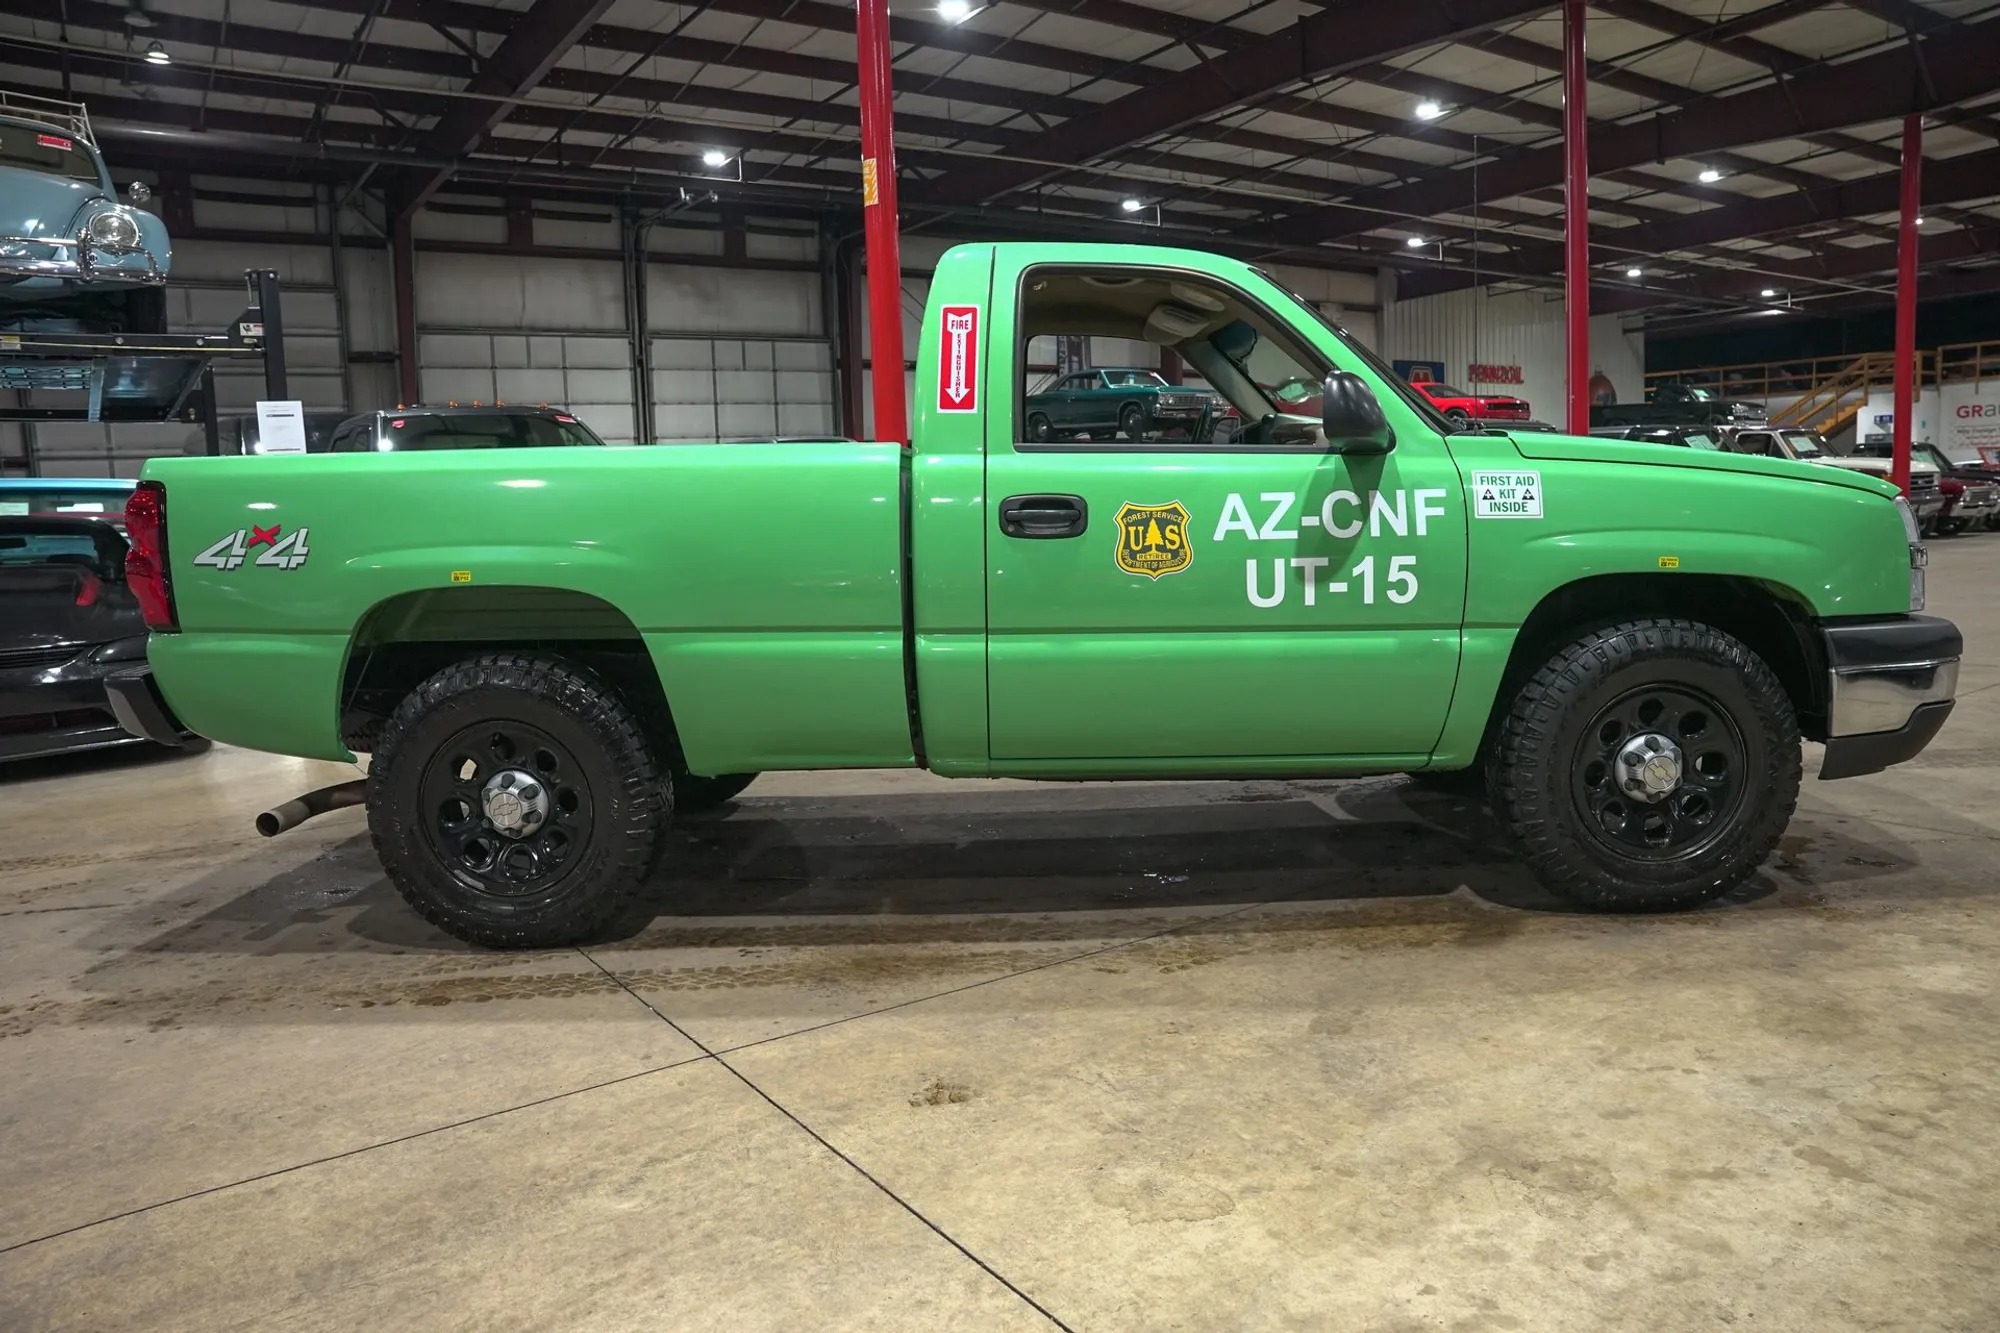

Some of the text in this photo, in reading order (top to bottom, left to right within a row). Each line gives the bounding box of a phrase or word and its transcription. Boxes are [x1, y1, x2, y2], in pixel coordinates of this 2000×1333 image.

[951, 320, 969, 330] FIRE
[1480, 476, 1535, 486] FIRST AID
[1499, 488, 1517, 499] KIT
[1489, 501, 1529, 512] INSIDE
[1123, 511, 1183, 525] FOREST SERVICE
[1213, 488, 1447, 541] AZ-CNF
[1128, 524, 1181, 551] U S
[1246, 555, 1419, 608] UT-15
